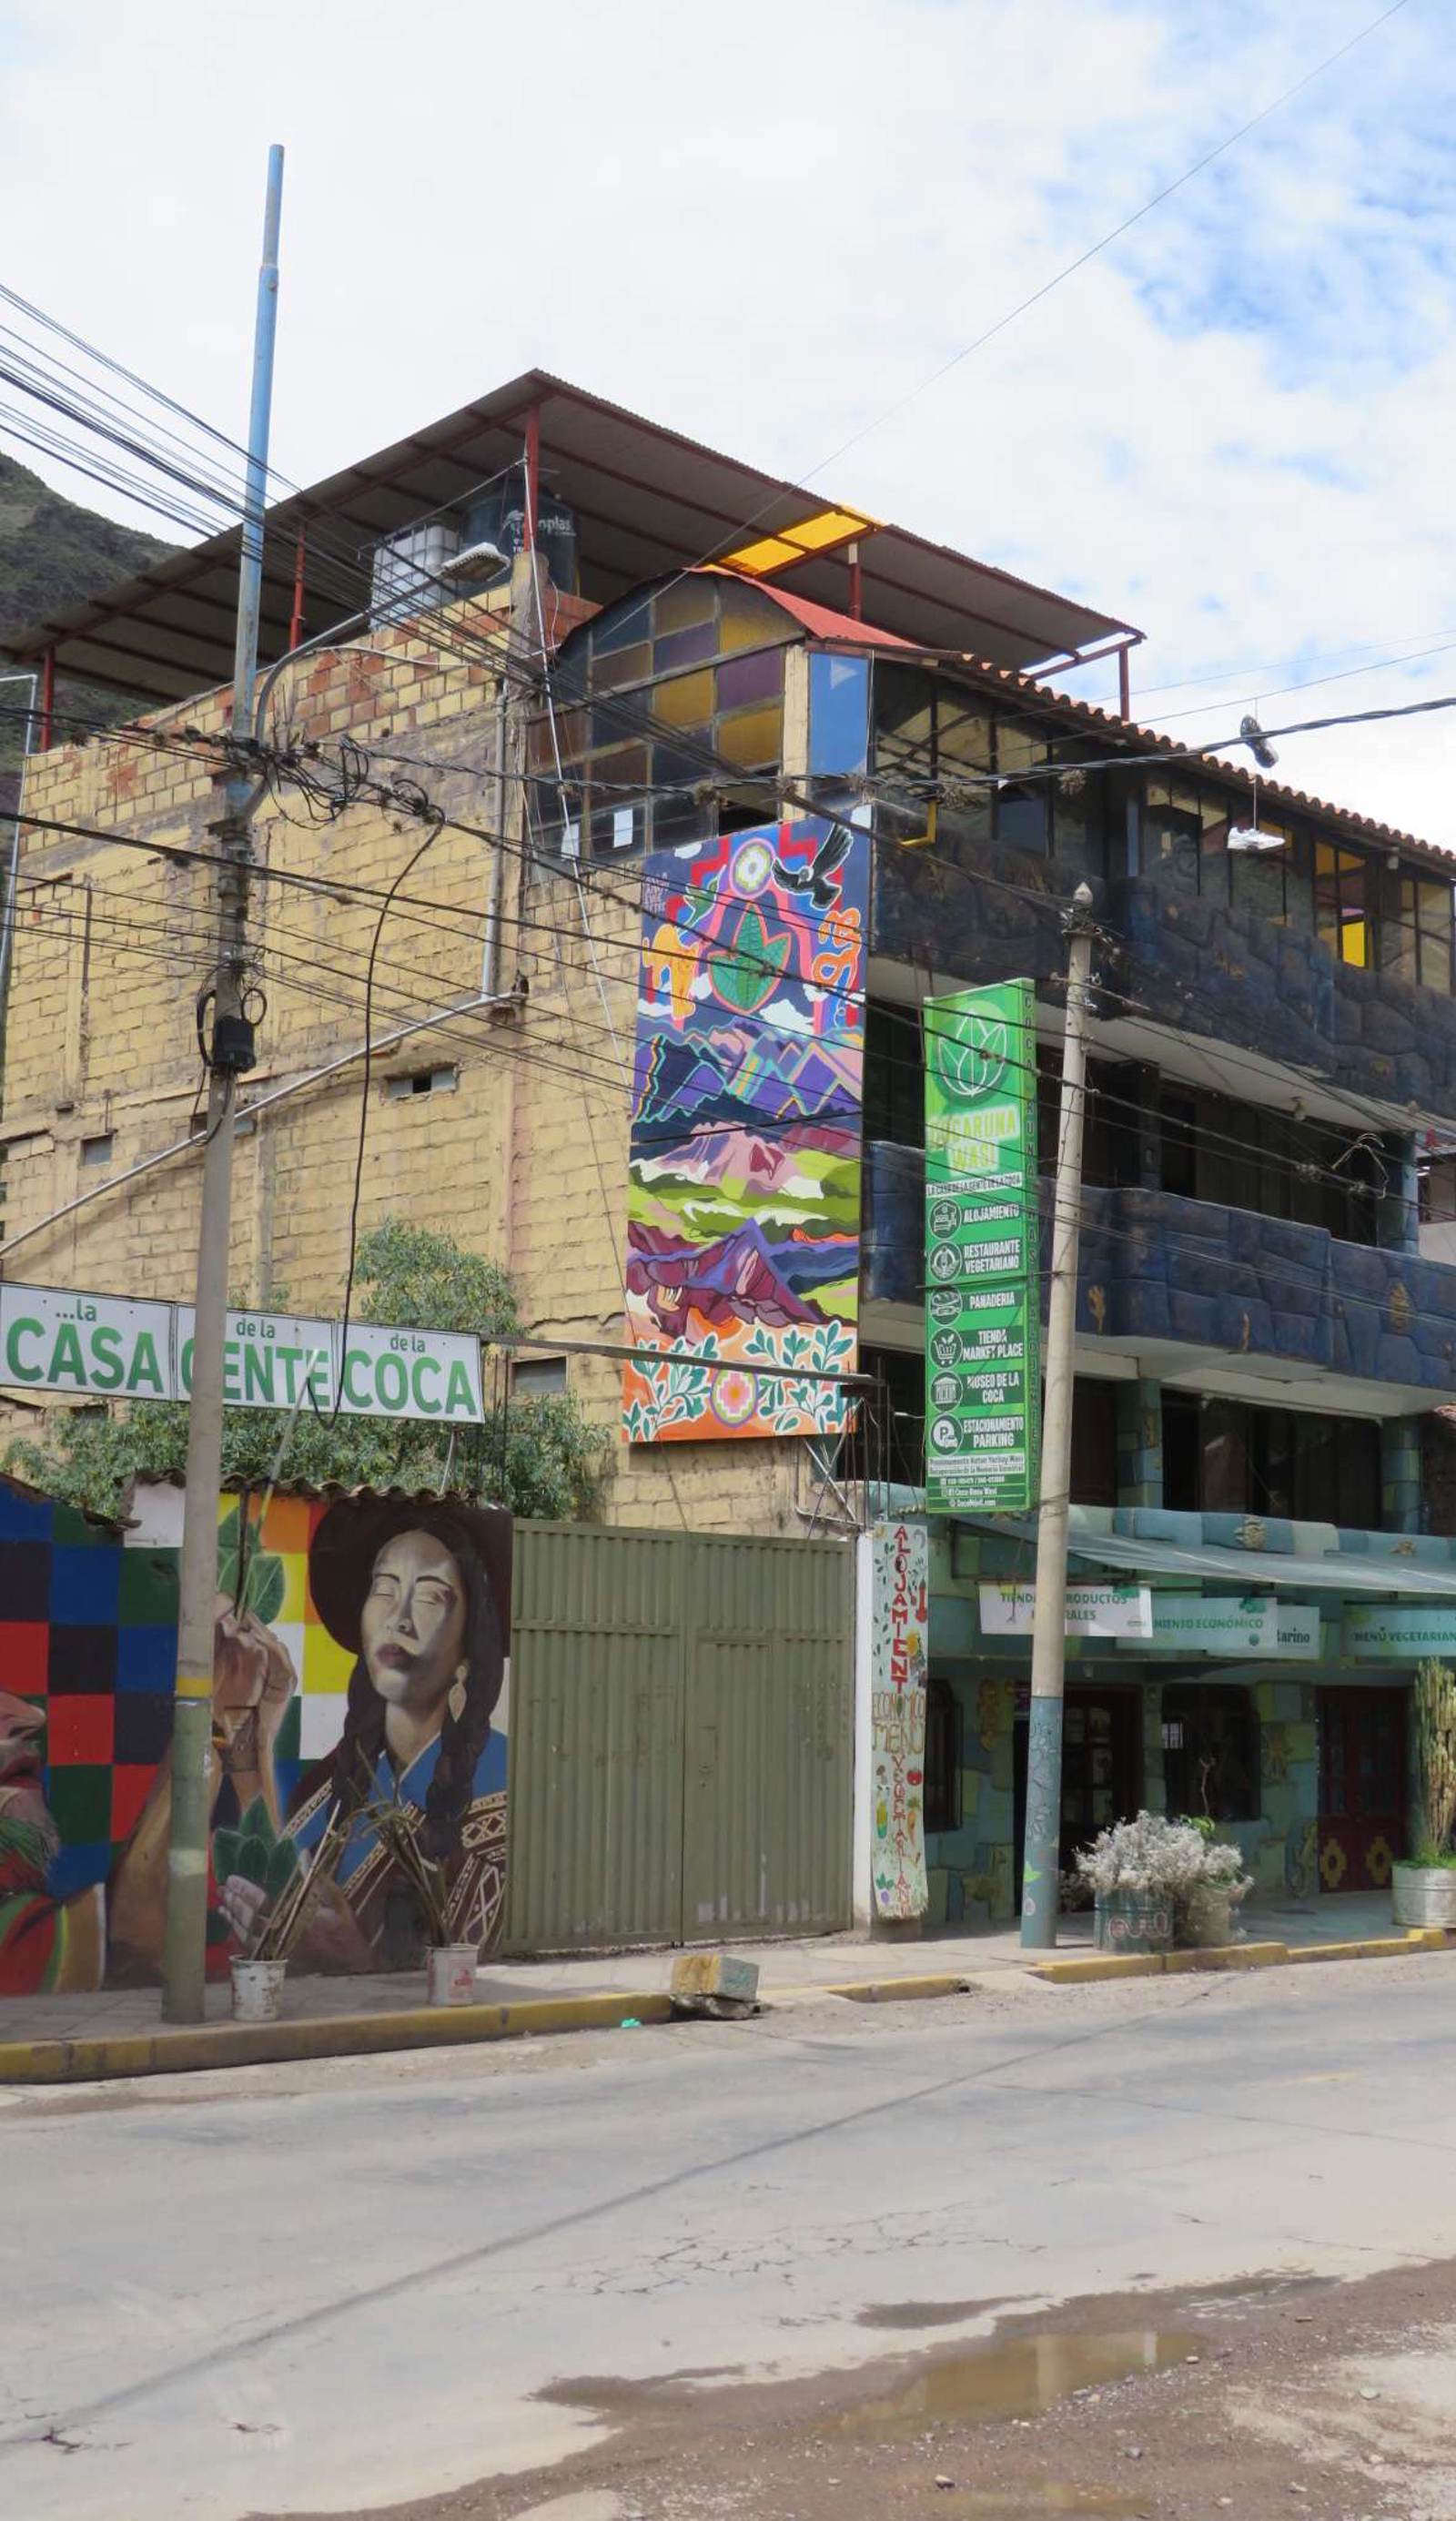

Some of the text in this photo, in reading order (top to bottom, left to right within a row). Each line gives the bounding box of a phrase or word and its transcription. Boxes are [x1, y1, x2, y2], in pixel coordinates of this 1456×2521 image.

[964, 1204, 1020, 1222] ALOJAMIENTO
[964, 1240, 1020, 1258] RESTAURANTE
[965, 1256, 1019, 1273] VEGETARIANO
[236, 1319, 276, 1338] de la
[978, 1329, 1007, 1345] TIENDA
[390, 1332, 426, 1352] de la
[997, 1342, 1023, 1357] PLACE
[6, 1316, 165, 1393] CASA
[344, 1349, 478, 1415] COCA
[967, 1372, 1019, 1389] MUSEO DE LA
[983, 1388, 1005, 1403] COCA
[964, 1416, 1023, 1433] ESTACIONAMIENTO
[974, 1433, 1014, 1448] PARKING
[1001, 1593, 1127, 1605] TIEND RODUCTOS
